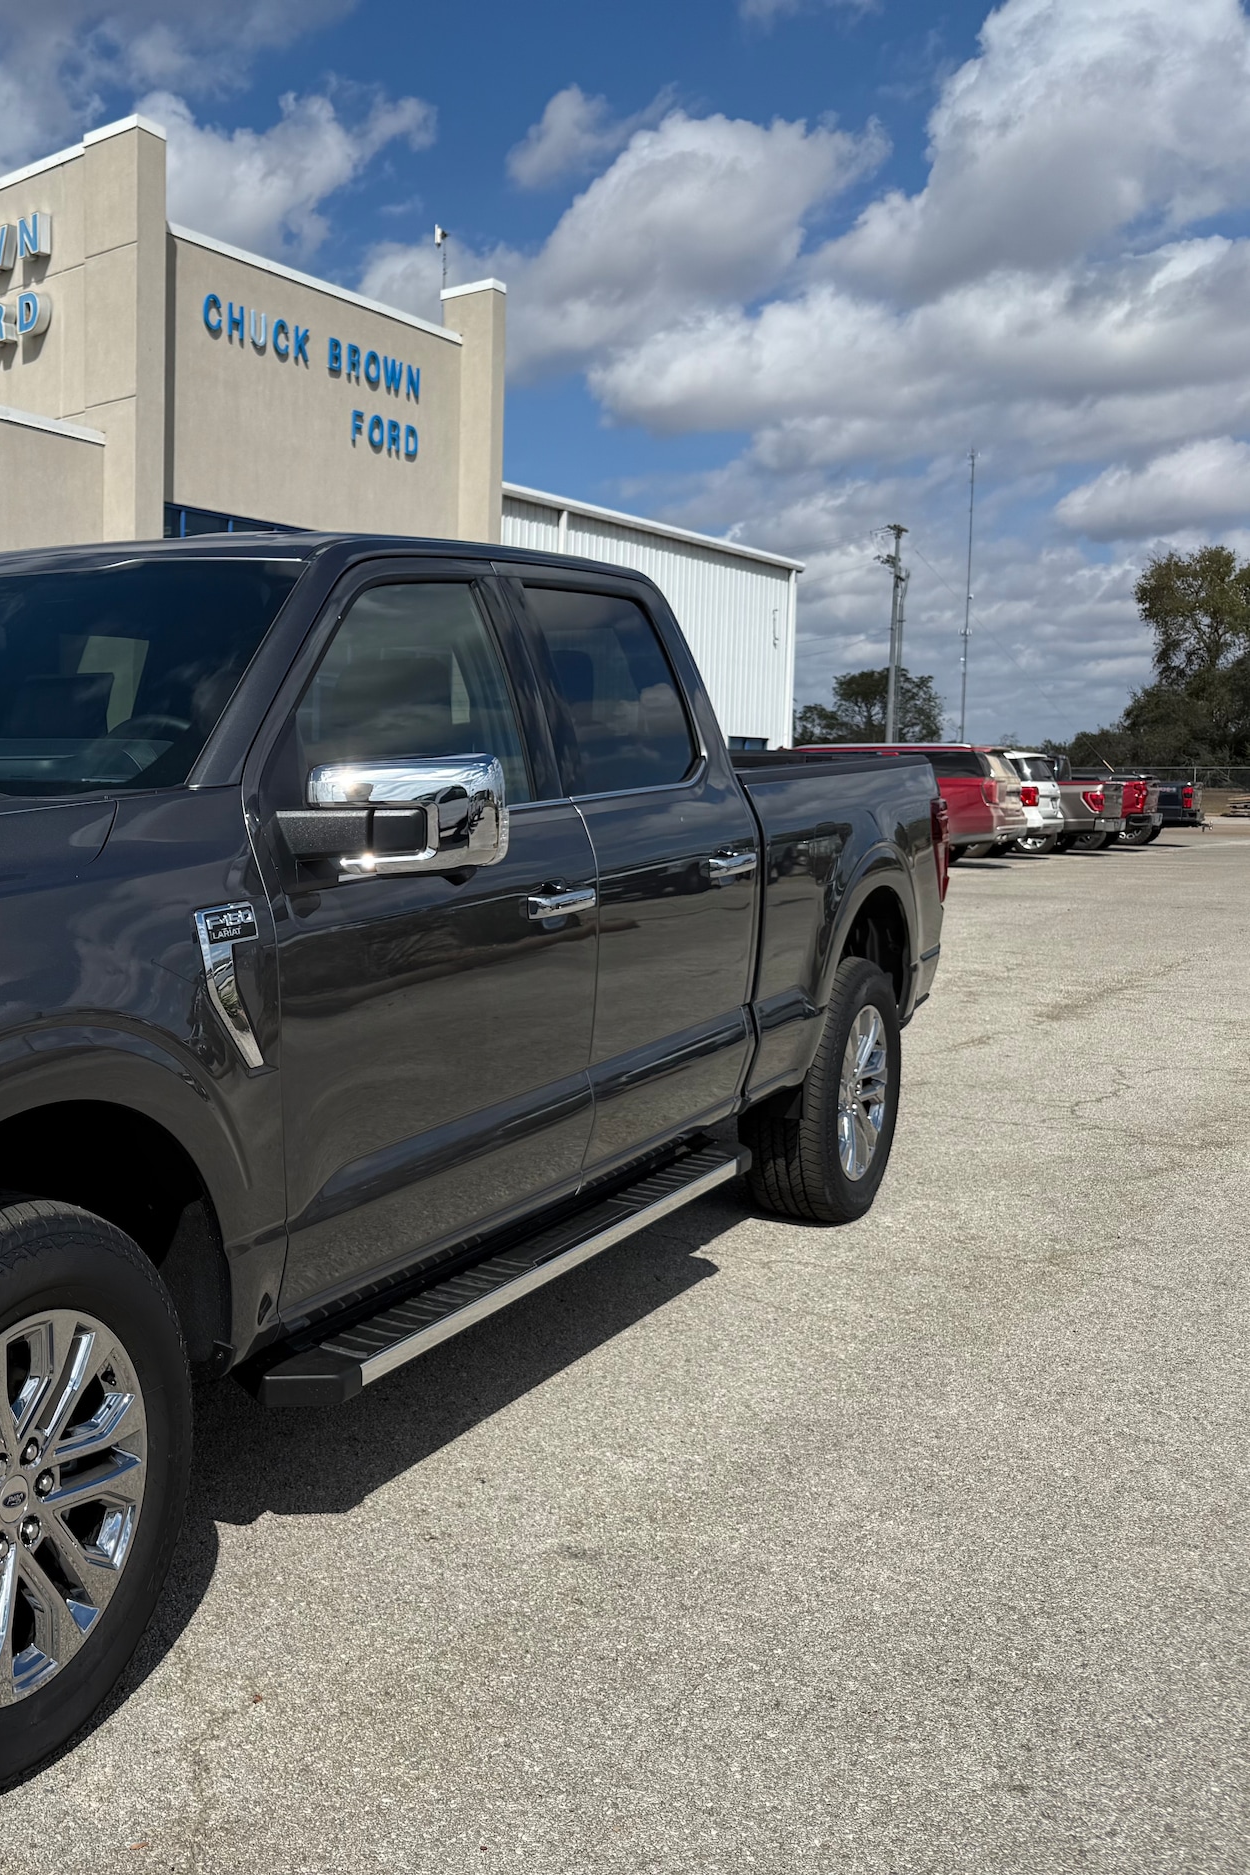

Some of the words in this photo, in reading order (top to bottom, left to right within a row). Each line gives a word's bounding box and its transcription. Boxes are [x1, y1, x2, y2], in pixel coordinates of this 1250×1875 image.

[203, 293, 310, 363] CHUCK
[327, 337, 421, 400] BROWN
[351, 409, 419, 457] FORD
[206, 909, 252, 930] F-150
[212, 925, 242, 940] LARIAT
